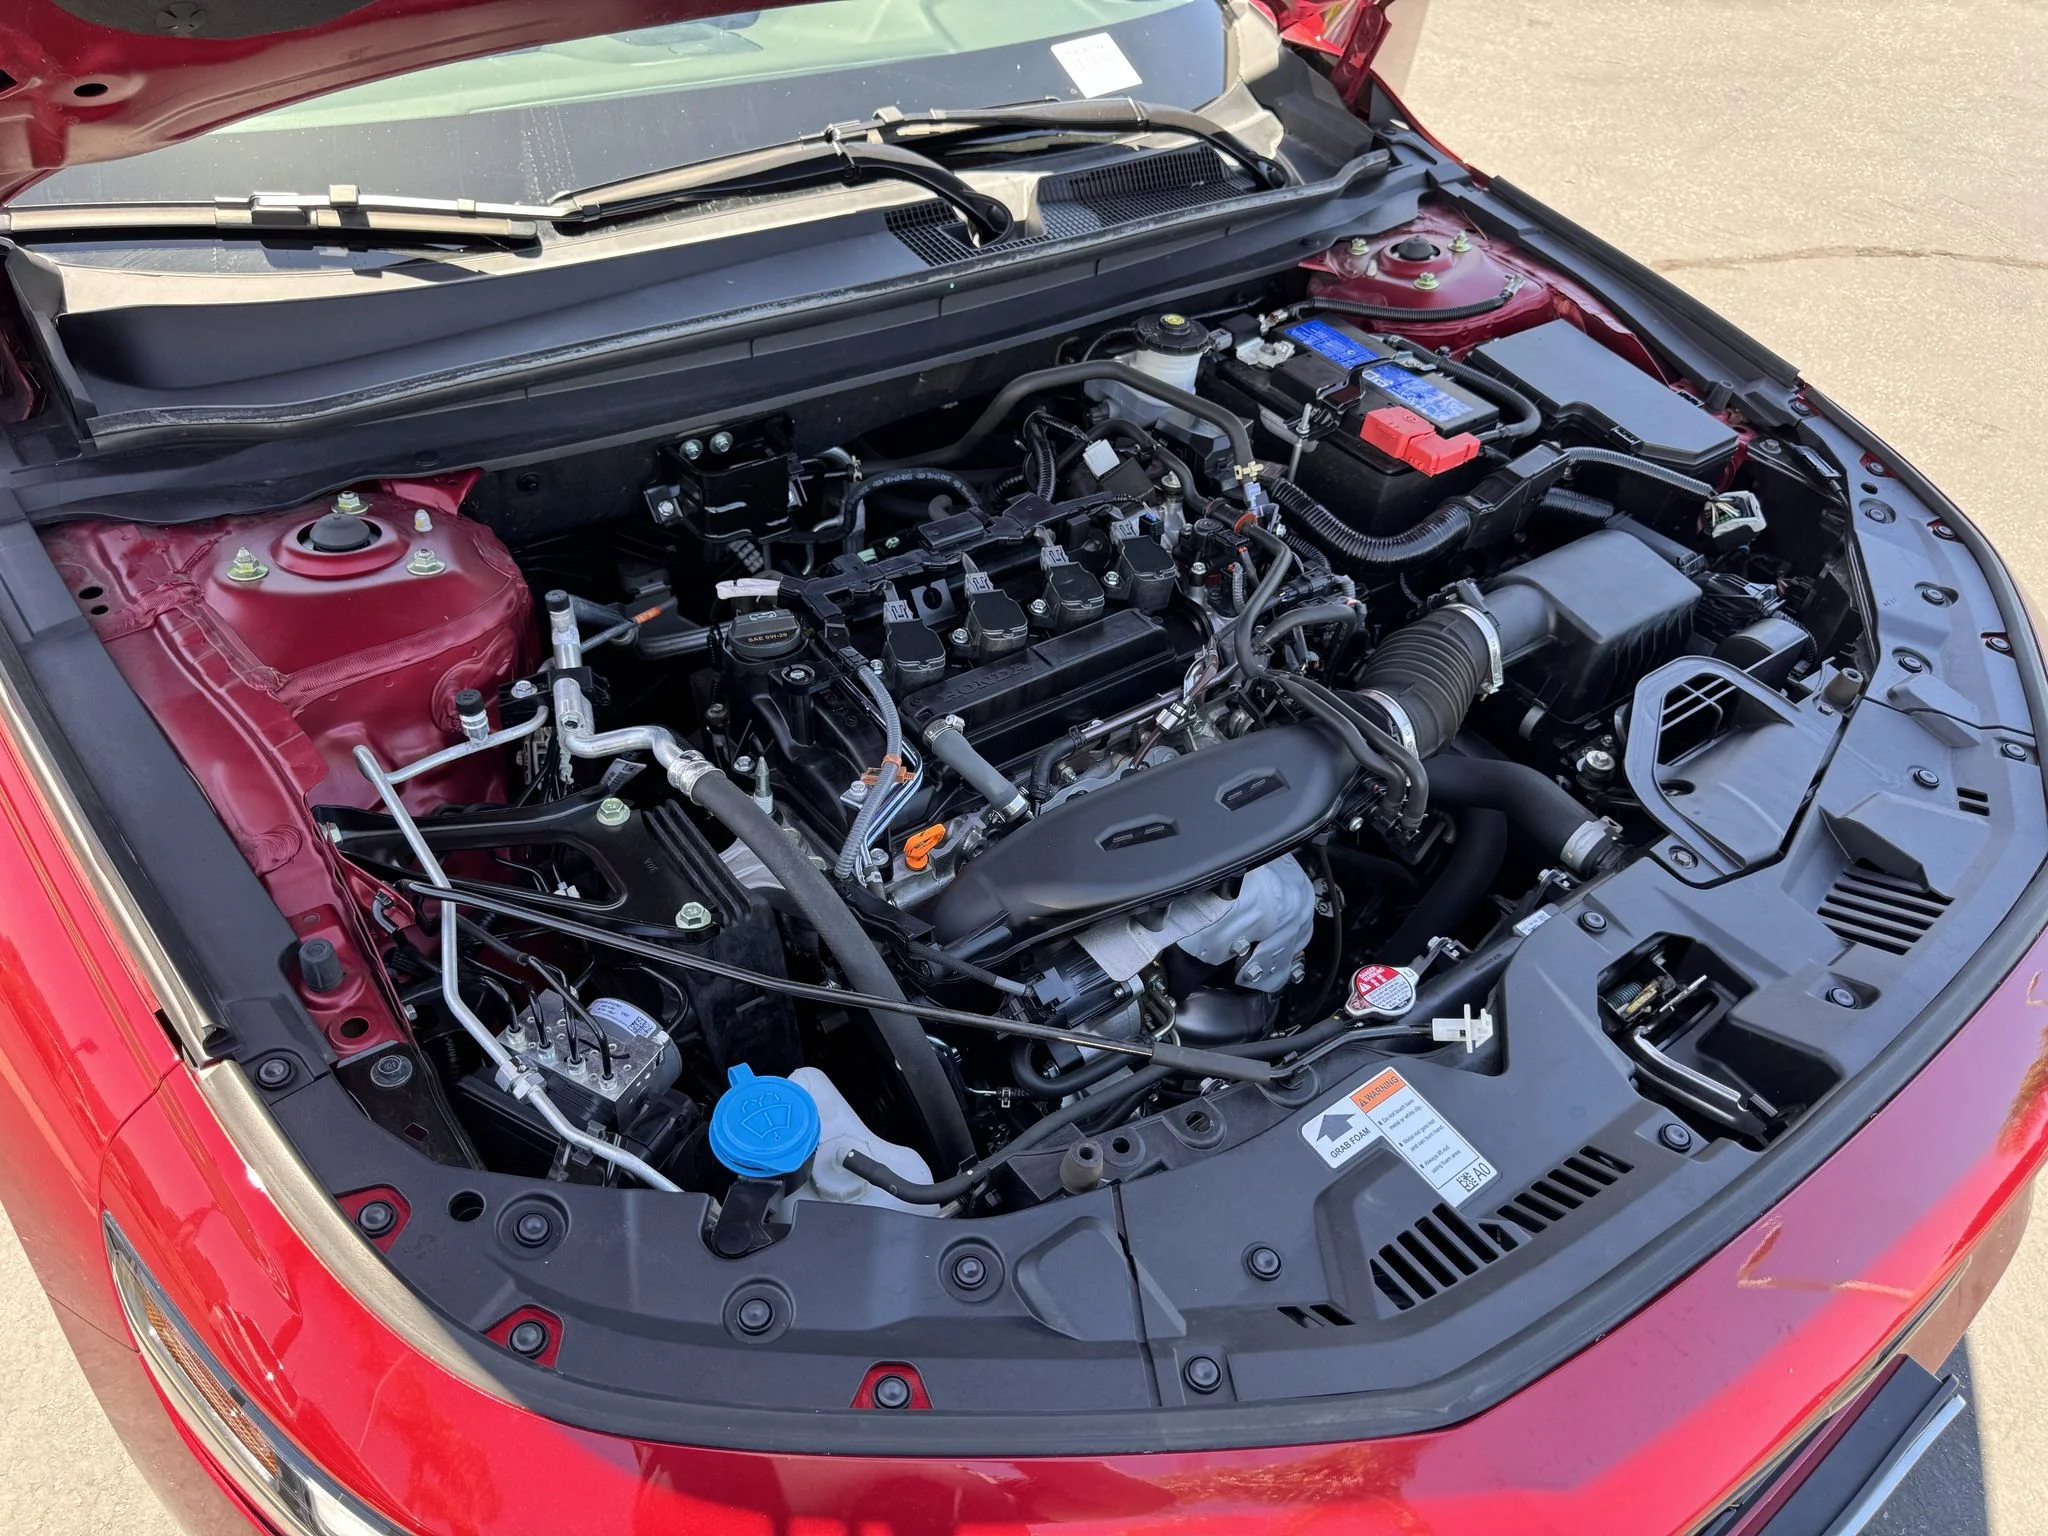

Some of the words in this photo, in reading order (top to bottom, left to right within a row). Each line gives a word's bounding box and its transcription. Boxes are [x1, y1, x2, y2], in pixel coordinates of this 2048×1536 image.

[941, 662, 1033, 703] HONDA
[1364, 1076, 1399, 1101] WARNING
[1330, 1141, 1352, 1159] GRAB
[1349, 1127, 1371, 1145] FOAM
